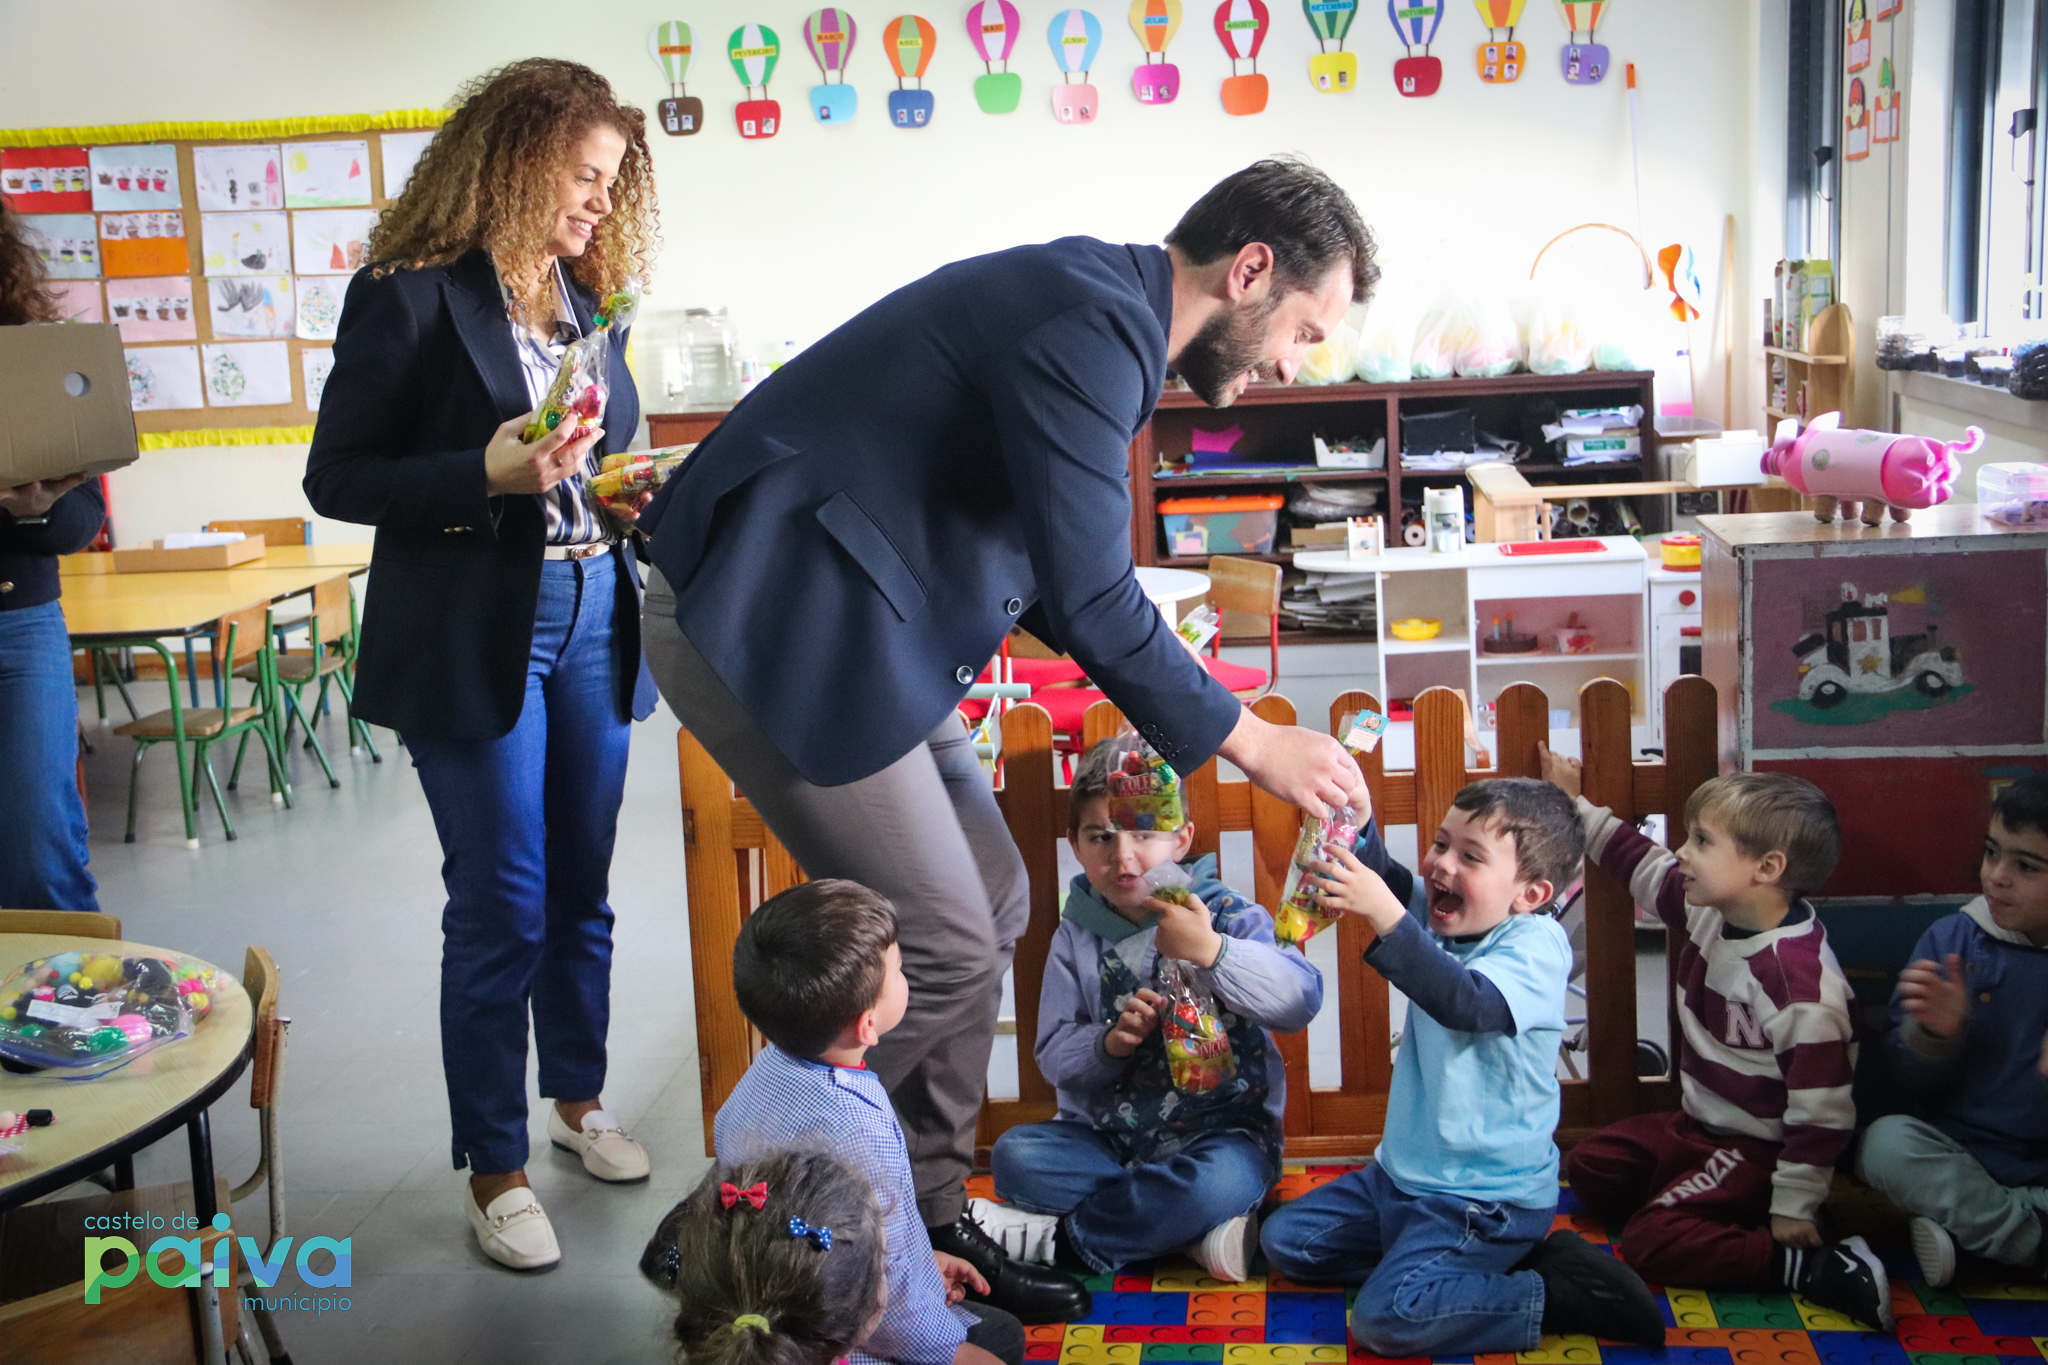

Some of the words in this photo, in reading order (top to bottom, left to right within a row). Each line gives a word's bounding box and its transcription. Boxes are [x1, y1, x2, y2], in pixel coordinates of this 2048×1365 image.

[1311, 2, 1353, 12] SETEMBRO
[1398, 7, 1435, 18] OUTUBRO
[1144, 17, 1169, 25] JULHO
[1226, 20, 1258, 30] AGOSTO
[983, 24, 1004, 33] MAIO
[898, 39, 922, 47] ABRIL
[1062, 37, 1087, 45] JUNHO
[658, 45, 691, 54] JANEIRO
[733, 47, 776, 58] FEVEREIRO
[1726, 1001, 1764, 1048] N
